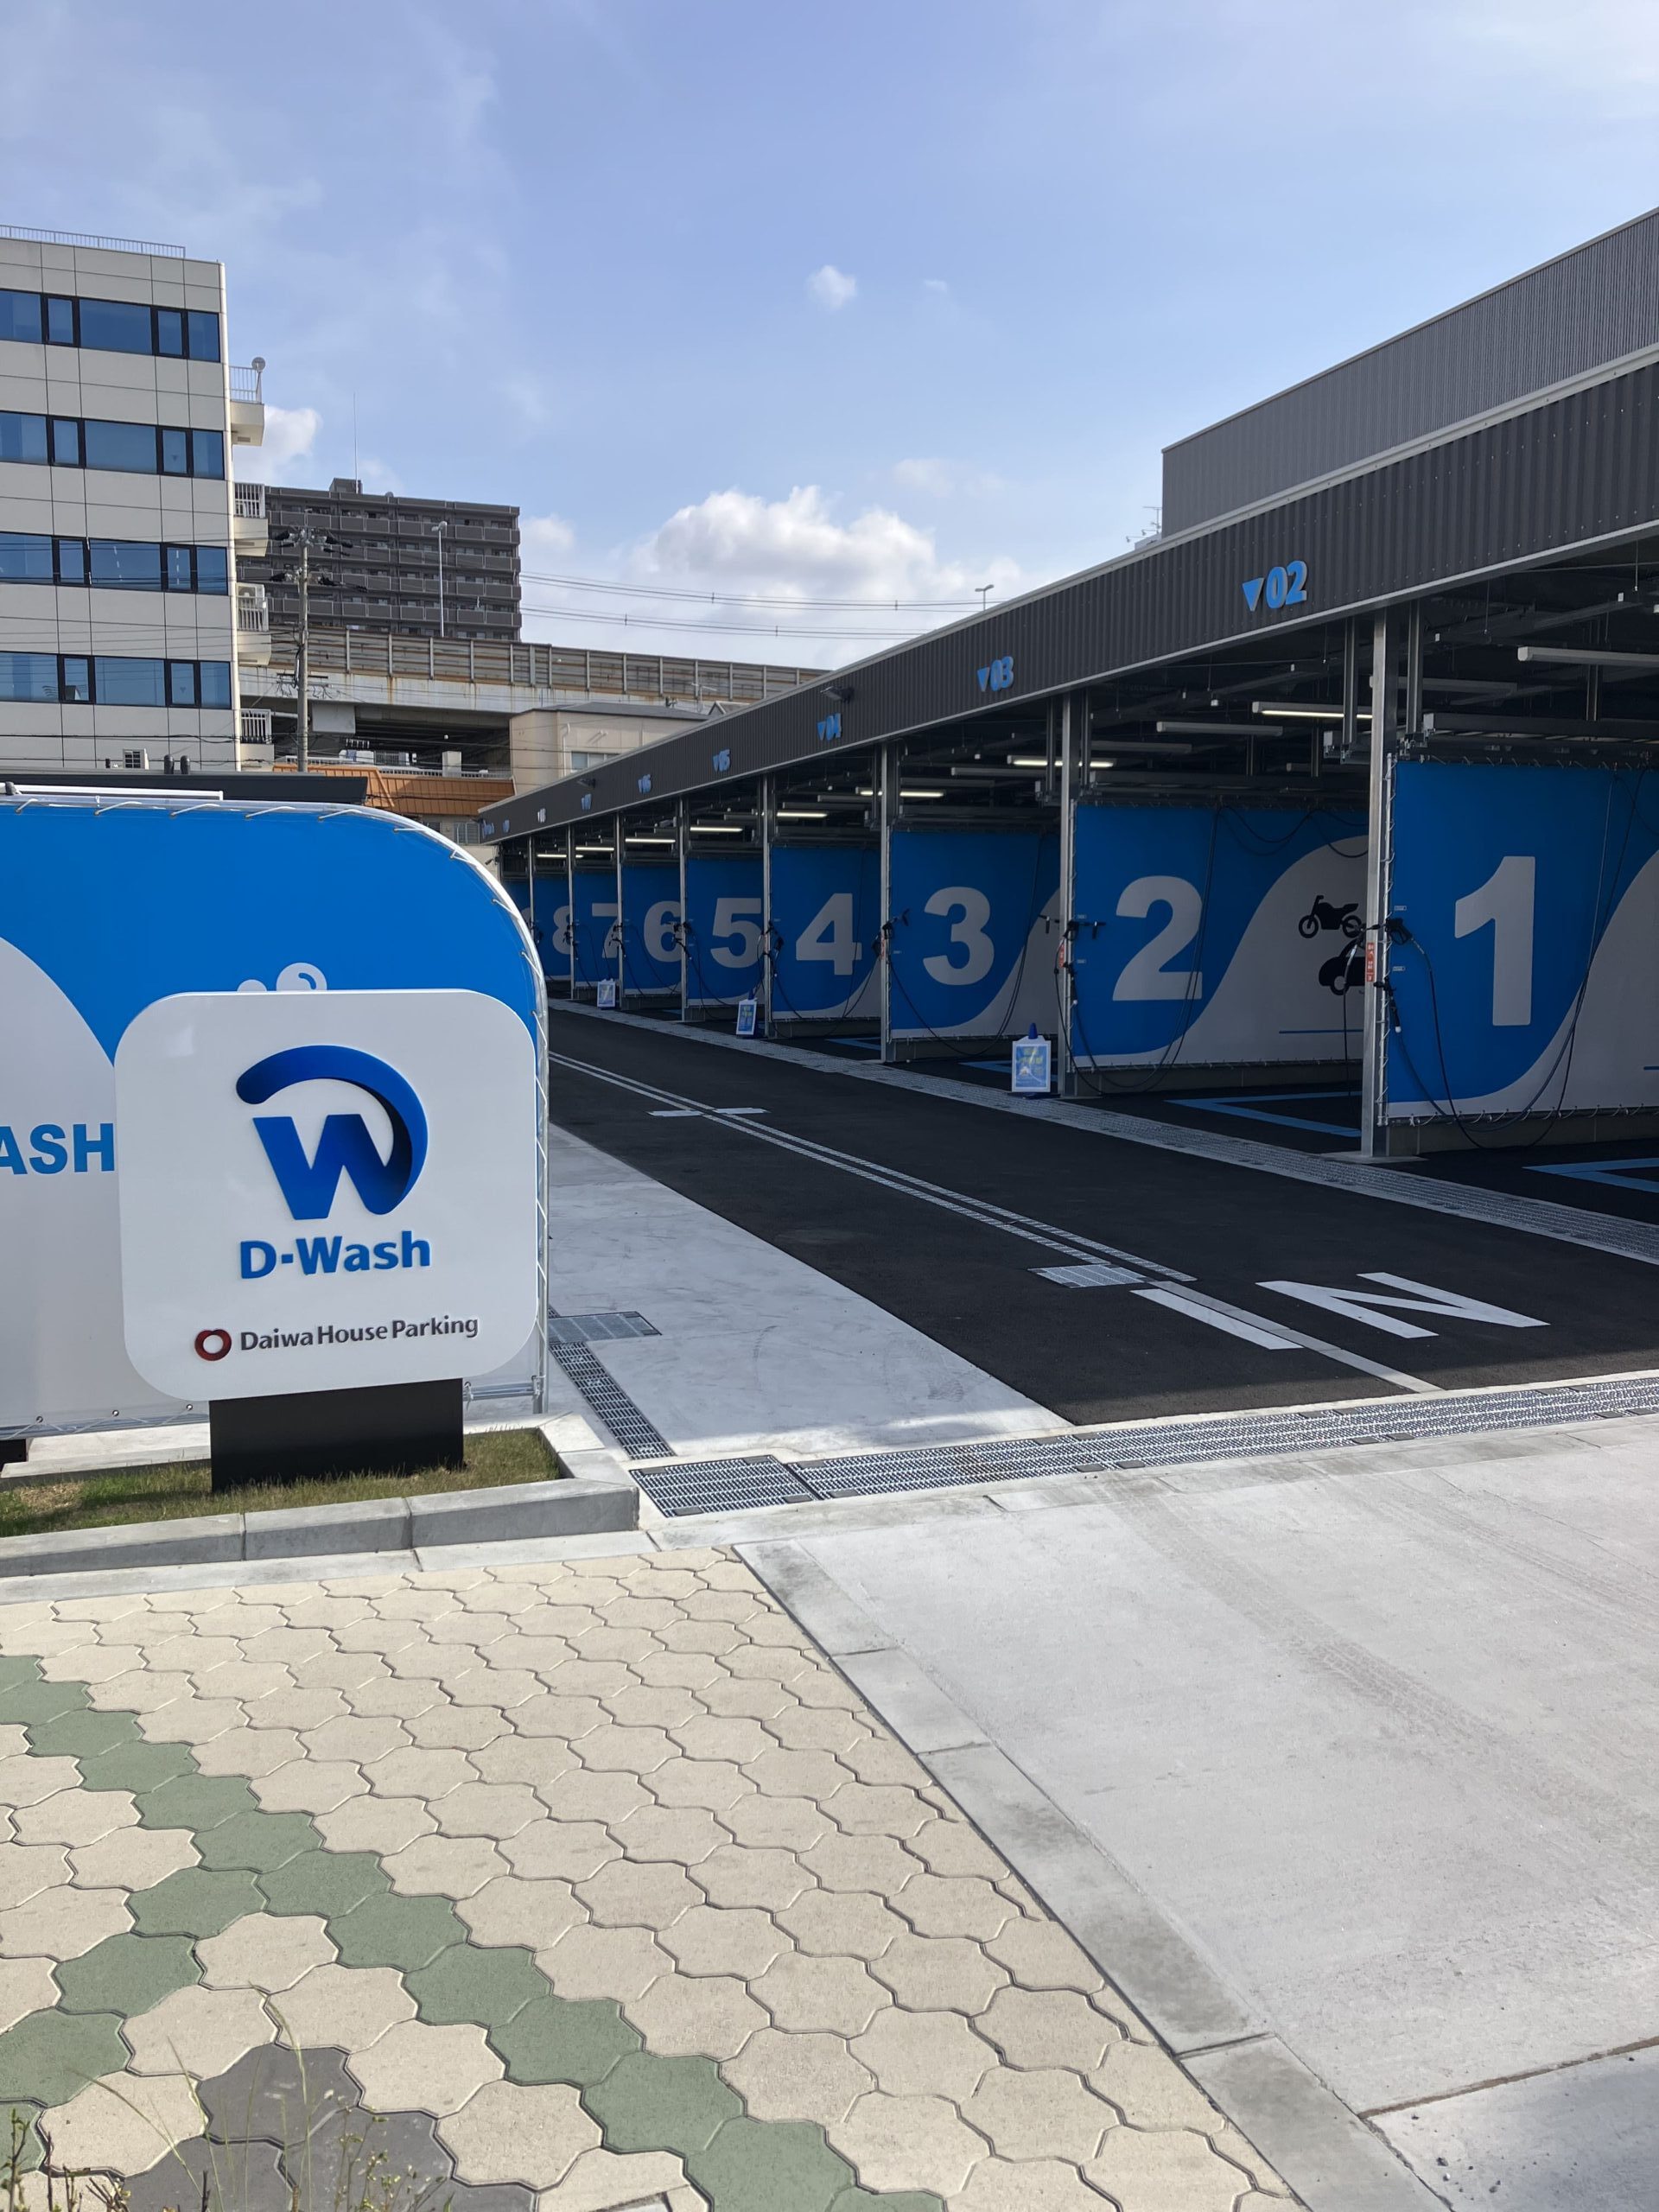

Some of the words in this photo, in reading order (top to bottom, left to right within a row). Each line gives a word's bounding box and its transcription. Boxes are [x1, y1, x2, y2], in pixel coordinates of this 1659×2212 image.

[1265, 560, 1308, 609] 02
[990, 656, 1014, 692] 03
[591, 902, 620, 959] 7
[644, 900, 683, 963] 6
[709, 897, 763, 969] 5
[795, 892, 862, 976] 4
[922, 886, 995, 985] 3
[1112, 874, 1203, 1001] 2
[1454, 855, 1536, 1027] 1
[239, 1230, 431, 1280] D-Wash
[240, 1327, 315, 1351] Daiwa
[317, 1325, 388, 1344] House
[391, 1314, 480, 1338] Parking
